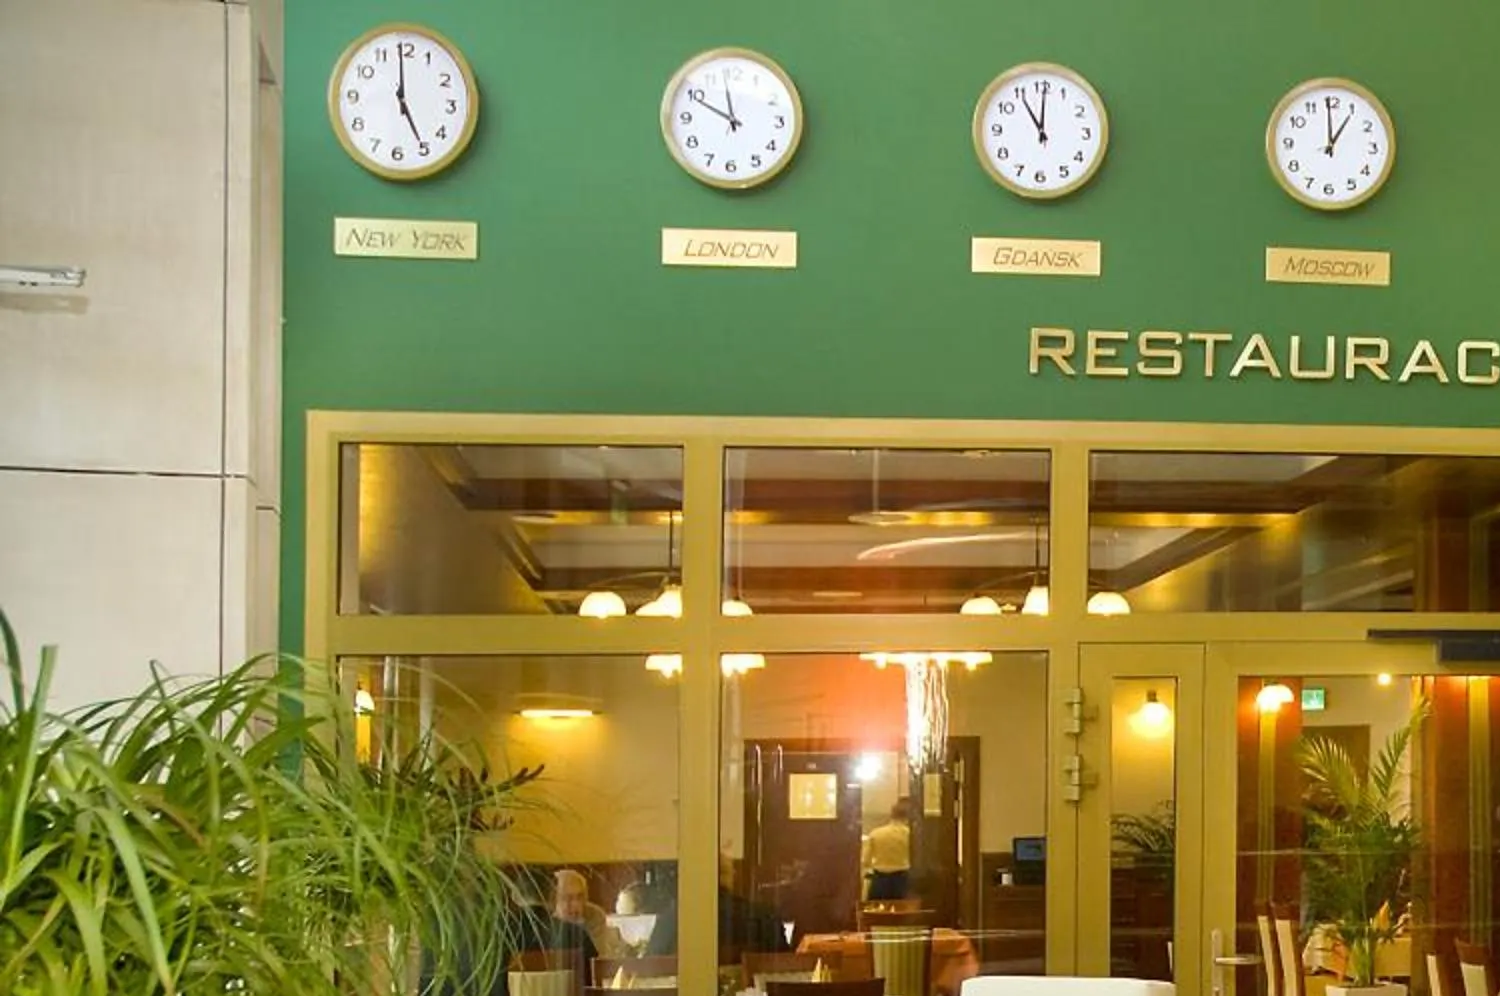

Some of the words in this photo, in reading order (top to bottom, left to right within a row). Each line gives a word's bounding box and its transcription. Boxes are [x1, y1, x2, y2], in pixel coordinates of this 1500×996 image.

[376, 48, 386, 62] 11
[426, 52, 431, 65] 1
[357, 65, 374, 78] 10
[440, 73, 450, 87] 2
[347, 90, 359, 104] 9
[688, 89, 705, 101] 10
[1015, 87, 1025, 98] 11
[1061, 88, 1066, 99] 1
[768, 93, 778, 106] 2
[446, 100, 457, 114] 3
[999, 102, 1014, 114] 10
[1075, 106, 1085, 118] 2
[1306, 102, 1316, 113] 11
[1350, 104, 1355, 115] 1
[352, 117, 364, 131] 8
[680, 112, 692, 124] 9
[775, 116, 784, 128] 3
[1290, 116, 1306, 128] 10
[992, 124, 1002, 136] 9
[1363, 120, 1372, 132] 2
[436, 125, 446, 140] 4
[1082, 128, 1091, 140] 3
[370, 139, 381, 152] 7
[686, 136, 698, 148] 8
[766, 140, 776, 151] 4
[1283, 138, 1294, 149] 9
[391, 146, 404, 160] 6
[419, 142, 430, 156] 5
[998, 148, 1008, 160] 8
[1368, 143, 1378, 155] 3
[704, 153, 714, 166] 7
[751, 155, 761, 167] 5
[1074, 151, 1083, 163] 4
[725, 160, 736, 172] 6
[1015, 165, 1024, 176] 7
[1059, 166, 1069, 178] 5
[1288, 160, 1298, 172] 8
[1361, 165, 1370, 176] 4
[1034, 171, 1046, 183] 6
[1305, 177, 1314, 189] 7
[1324, 184, 1334, 195] 6
[1347, 179, 1356, 190] 5
